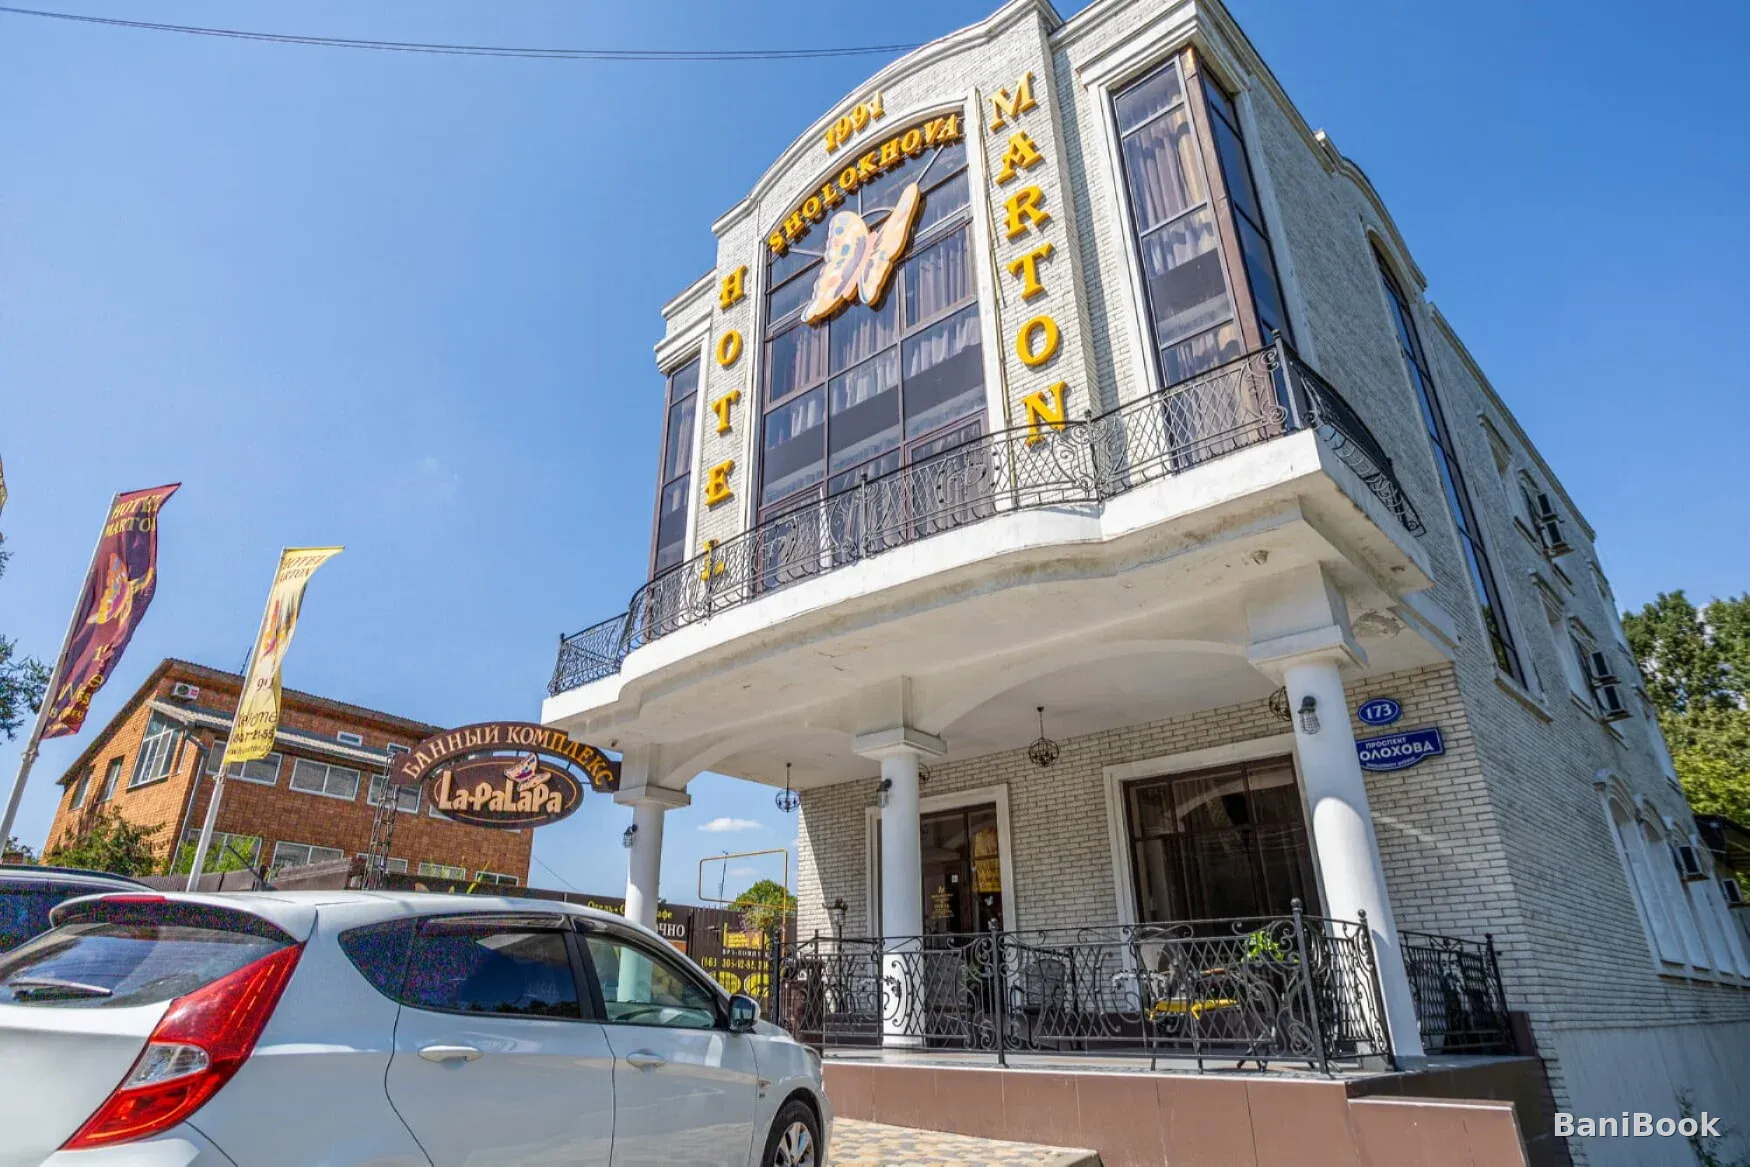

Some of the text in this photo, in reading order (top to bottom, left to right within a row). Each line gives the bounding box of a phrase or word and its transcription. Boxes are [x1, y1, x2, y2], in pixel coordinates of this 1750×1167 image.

[825, 91, 885, 152] 1991
[769, 114, 961, 253] SHOLOKHOVA
[990, 71, 1068, 447] MARTON
[1366, 703, 1391, 719] 173
[401, 724, 614, 786] БАННЫЙ КОМПЛЕКС
[1360, 740, 1434, 761] ОЛОХОВА
[1365, 736, 1407, 750] ПРОСПЕКТ
